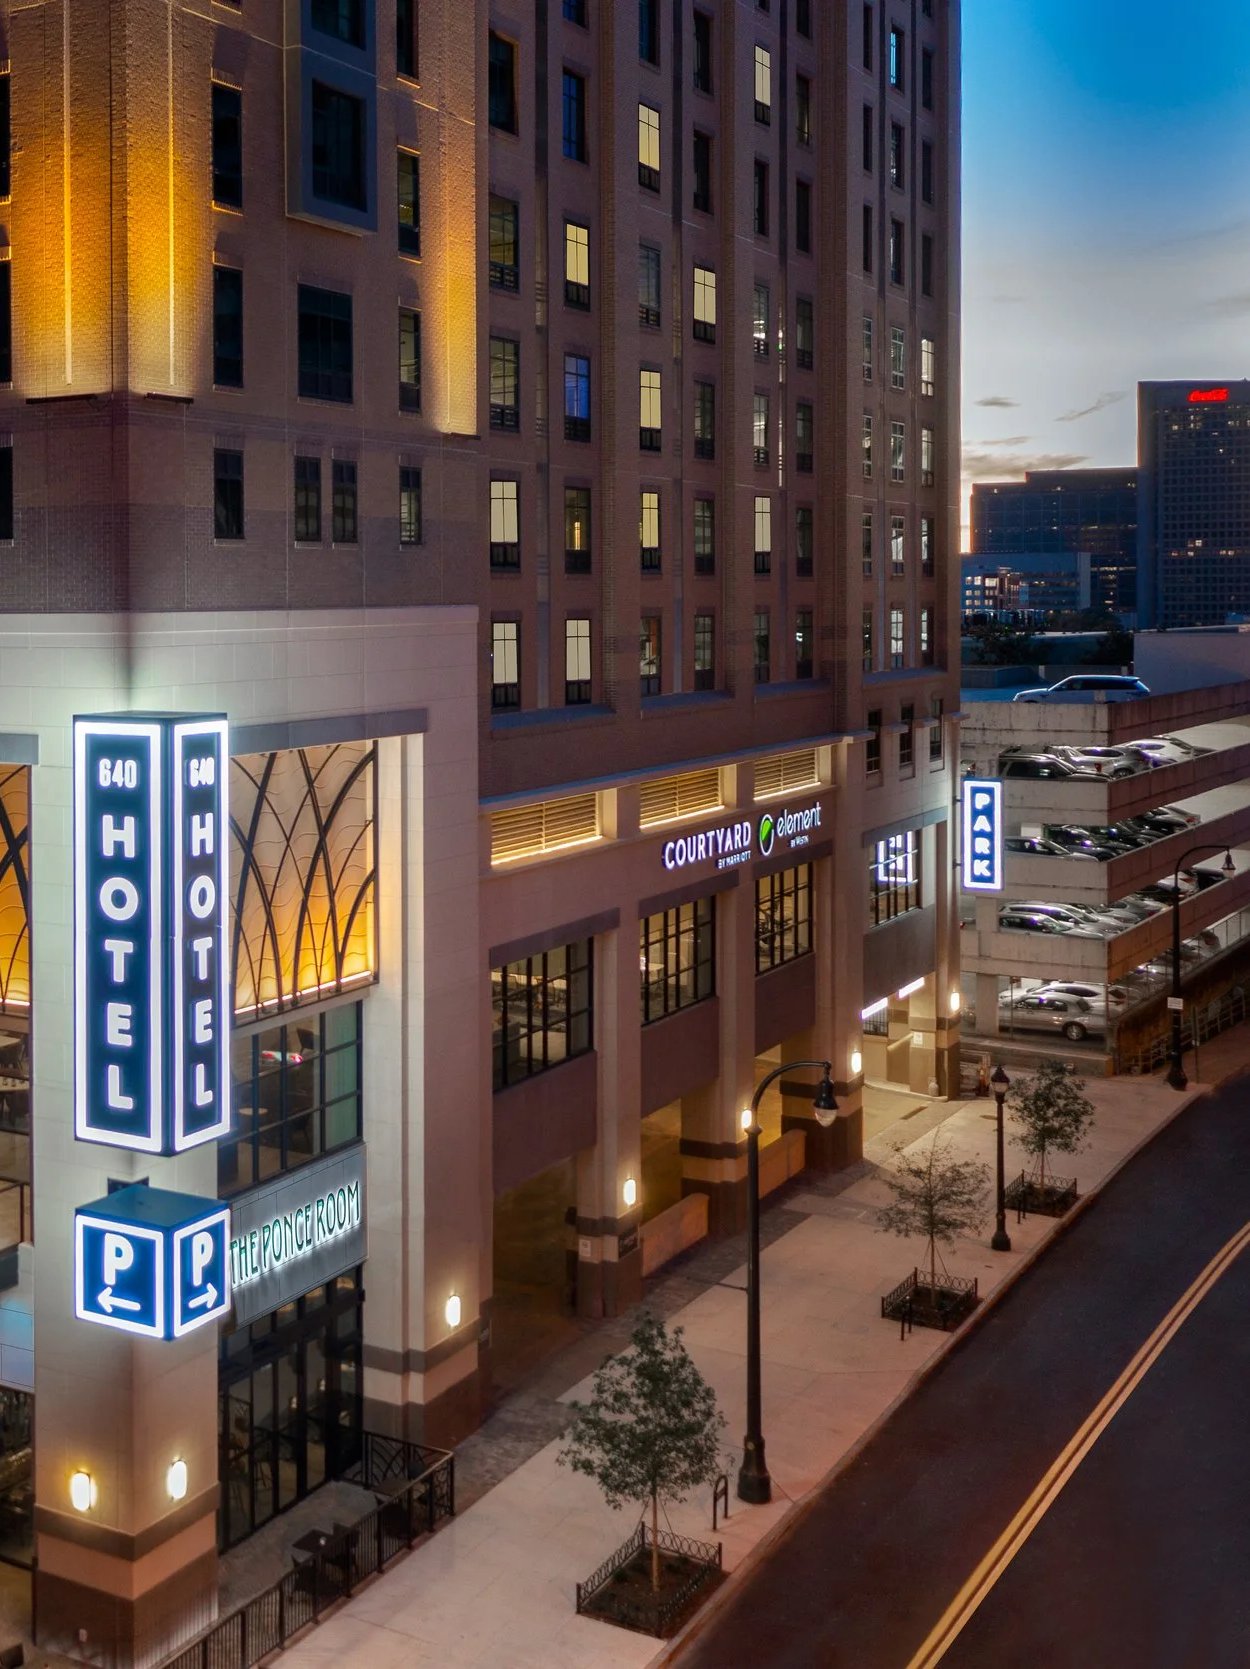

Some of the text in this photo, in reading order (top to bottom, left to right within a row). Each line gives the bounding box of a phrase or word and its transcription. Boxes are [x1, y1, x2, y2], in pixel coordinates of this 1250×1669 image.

[99, 758, 137, 788] 640
[190, 757, 215, 787] 640
[664, 821, 751, 870] COURTYARD
[777, 801, 821, 837] element
[973, 792, 991, 877] PARK
[718, 850, 751, 869] BY MARRIOTT
[99, 813, 139, 1110] HOTEL
[189, 812, 215, 1106] HOTEL
[191, 1232, 214, 1287] P
[230, 1180, 360, 1285] THE PONCE ROOM
[103, 1233, 135, 1287] P
